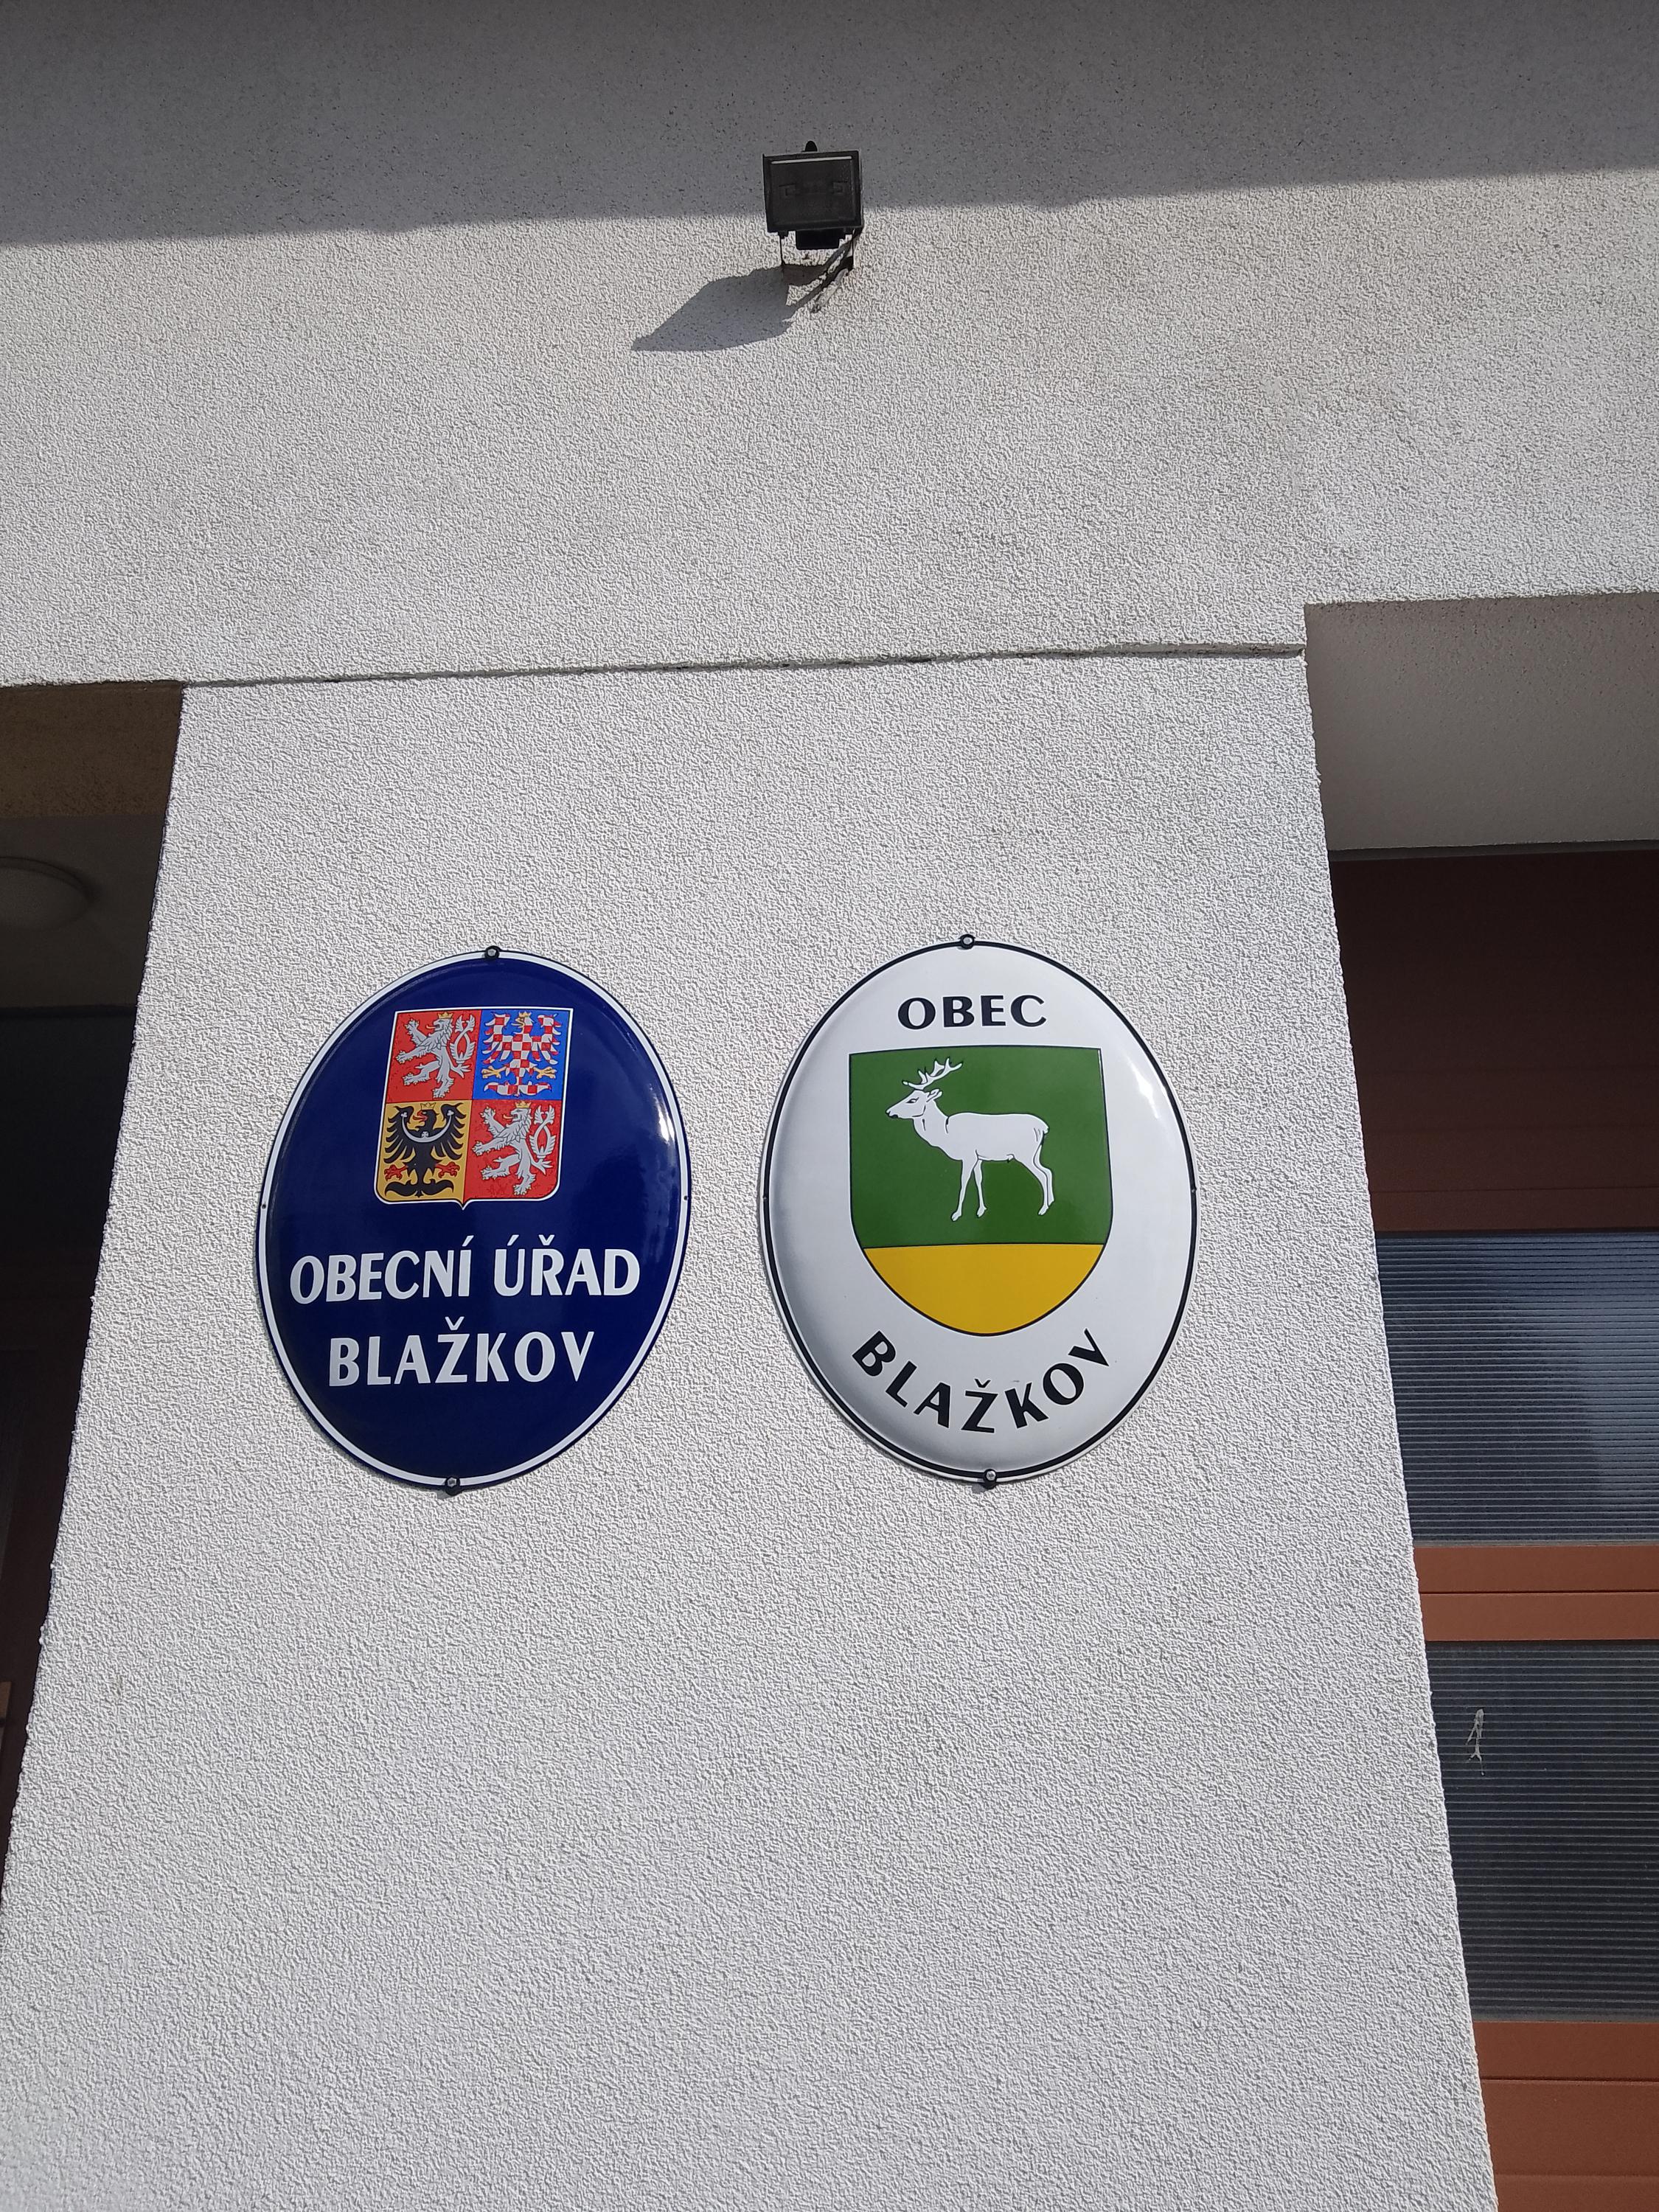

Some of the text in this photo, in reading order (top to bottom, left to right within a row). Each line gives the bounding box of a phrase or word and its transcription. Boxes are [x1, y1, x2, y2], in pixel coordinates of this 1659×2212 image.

[897, 993, 1048, 1030] OBEC
[289, 1234, 641, 1305] OBECNÍ ÚŘAD
[328, 1316, 596, 1387] BLAŽKOV
[852, 1328, 1110, 1434] BLAŽKOV
